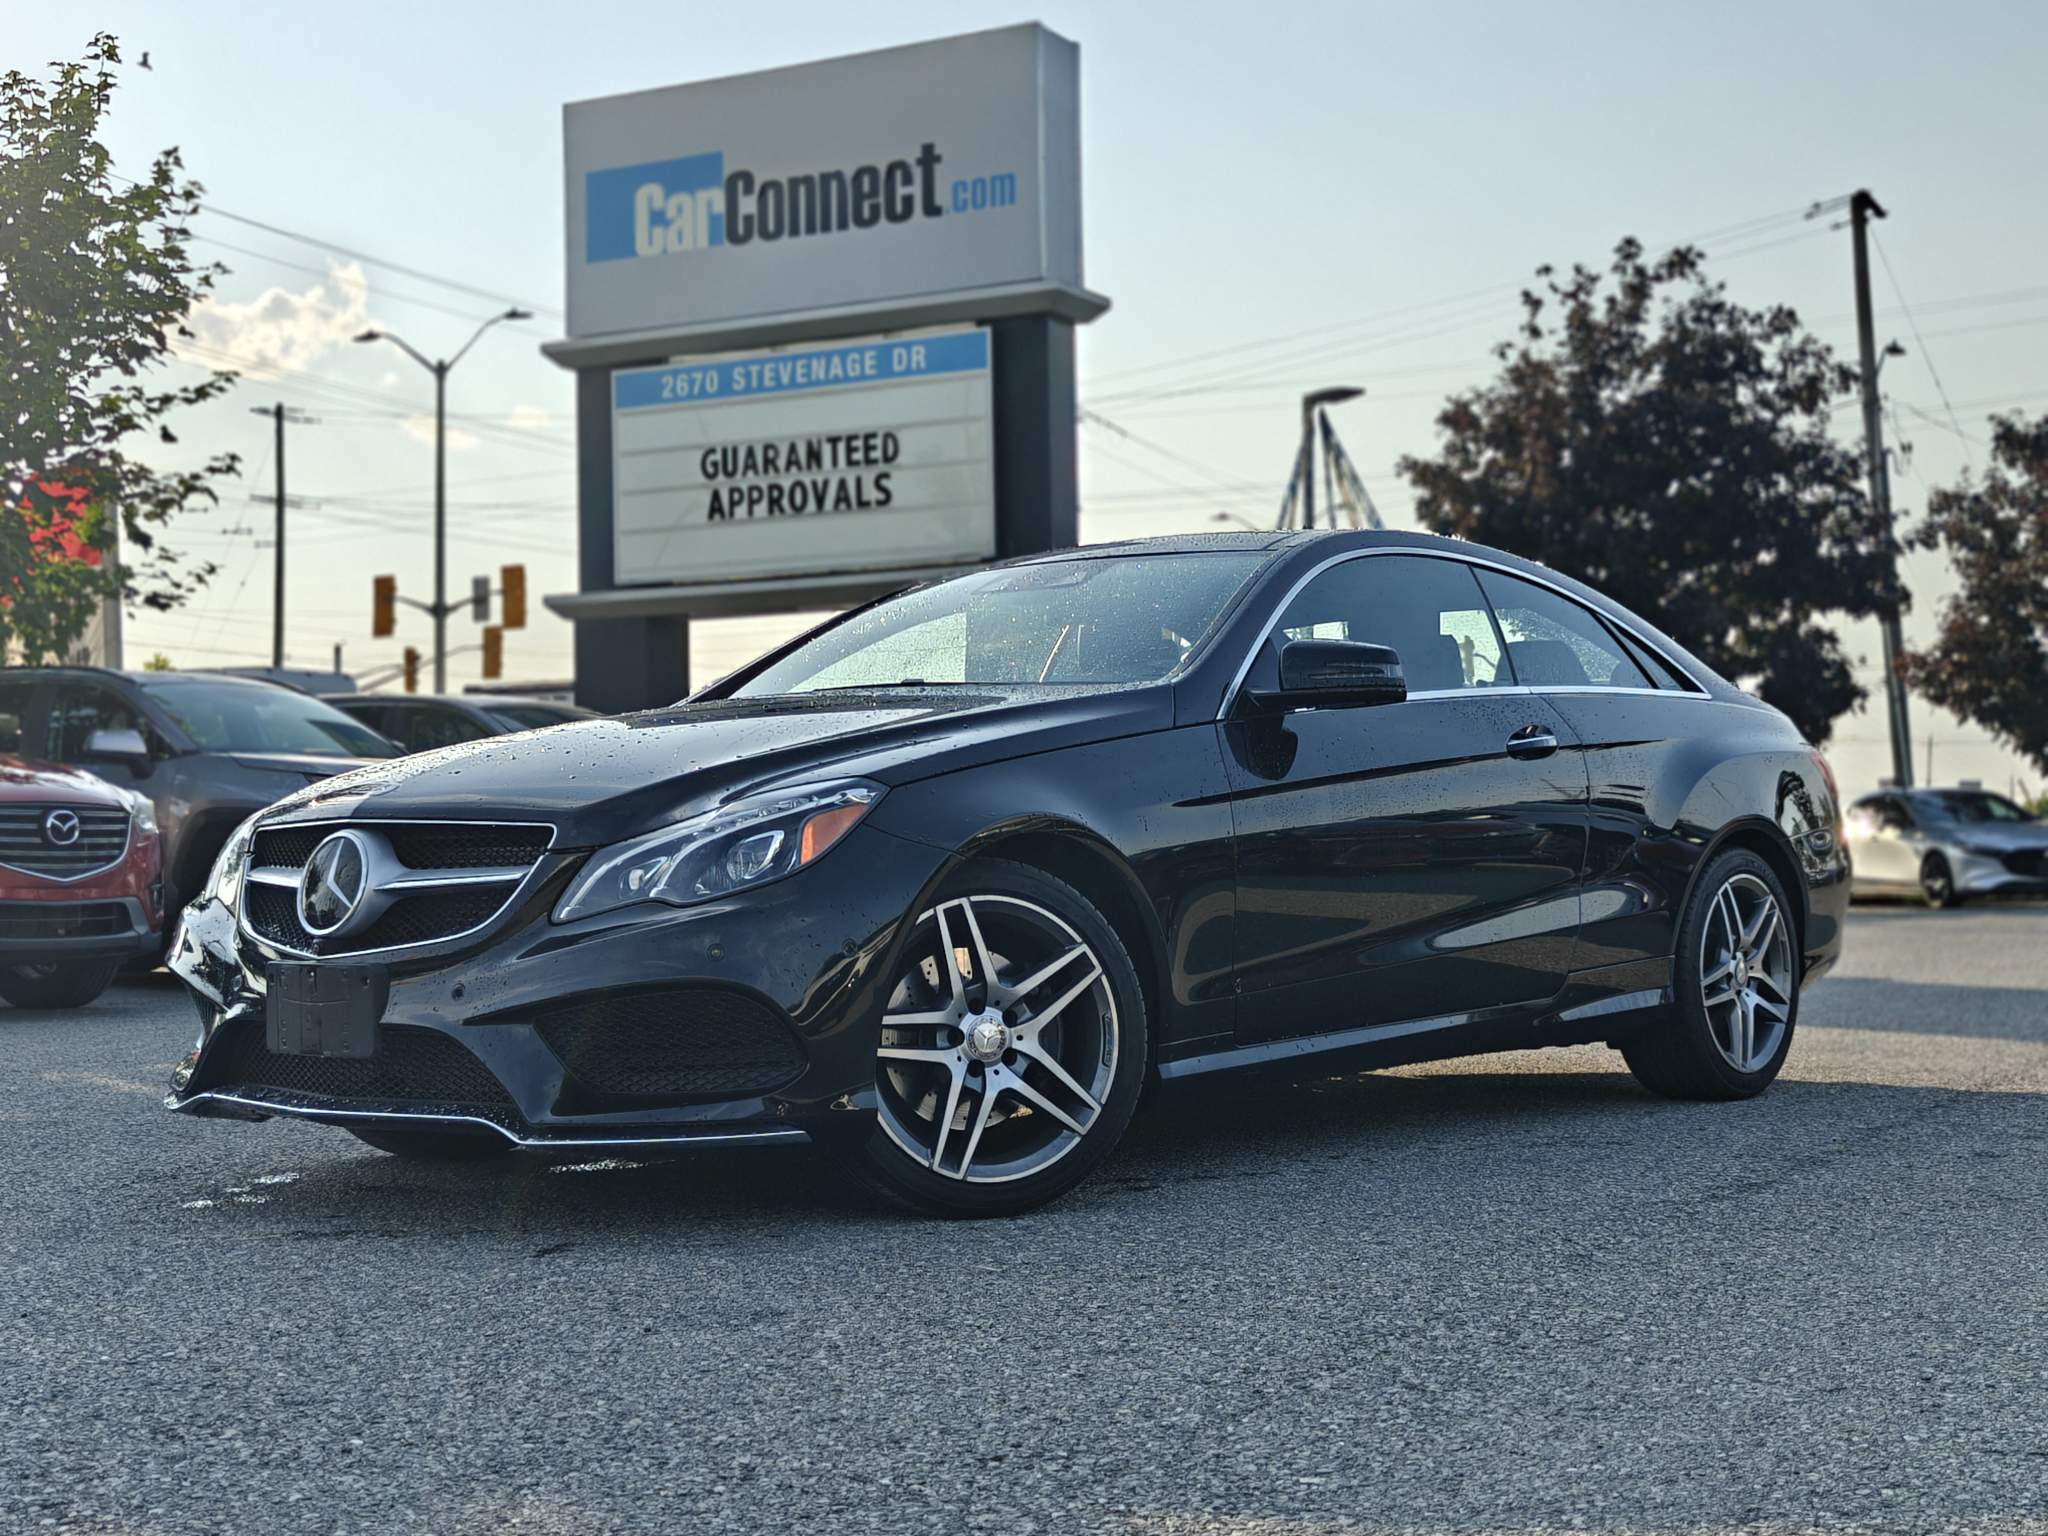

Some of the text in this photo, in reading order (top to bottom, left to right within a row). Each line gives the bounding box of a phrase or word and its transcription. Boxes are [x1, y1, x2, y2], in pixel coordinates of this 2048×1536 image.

[661, 346, 927, 399] 2670 STEVENAGE DR
[701, 432, 900, 480] GUARANTEED
[707, 473, 892, 521] APPROVALS
